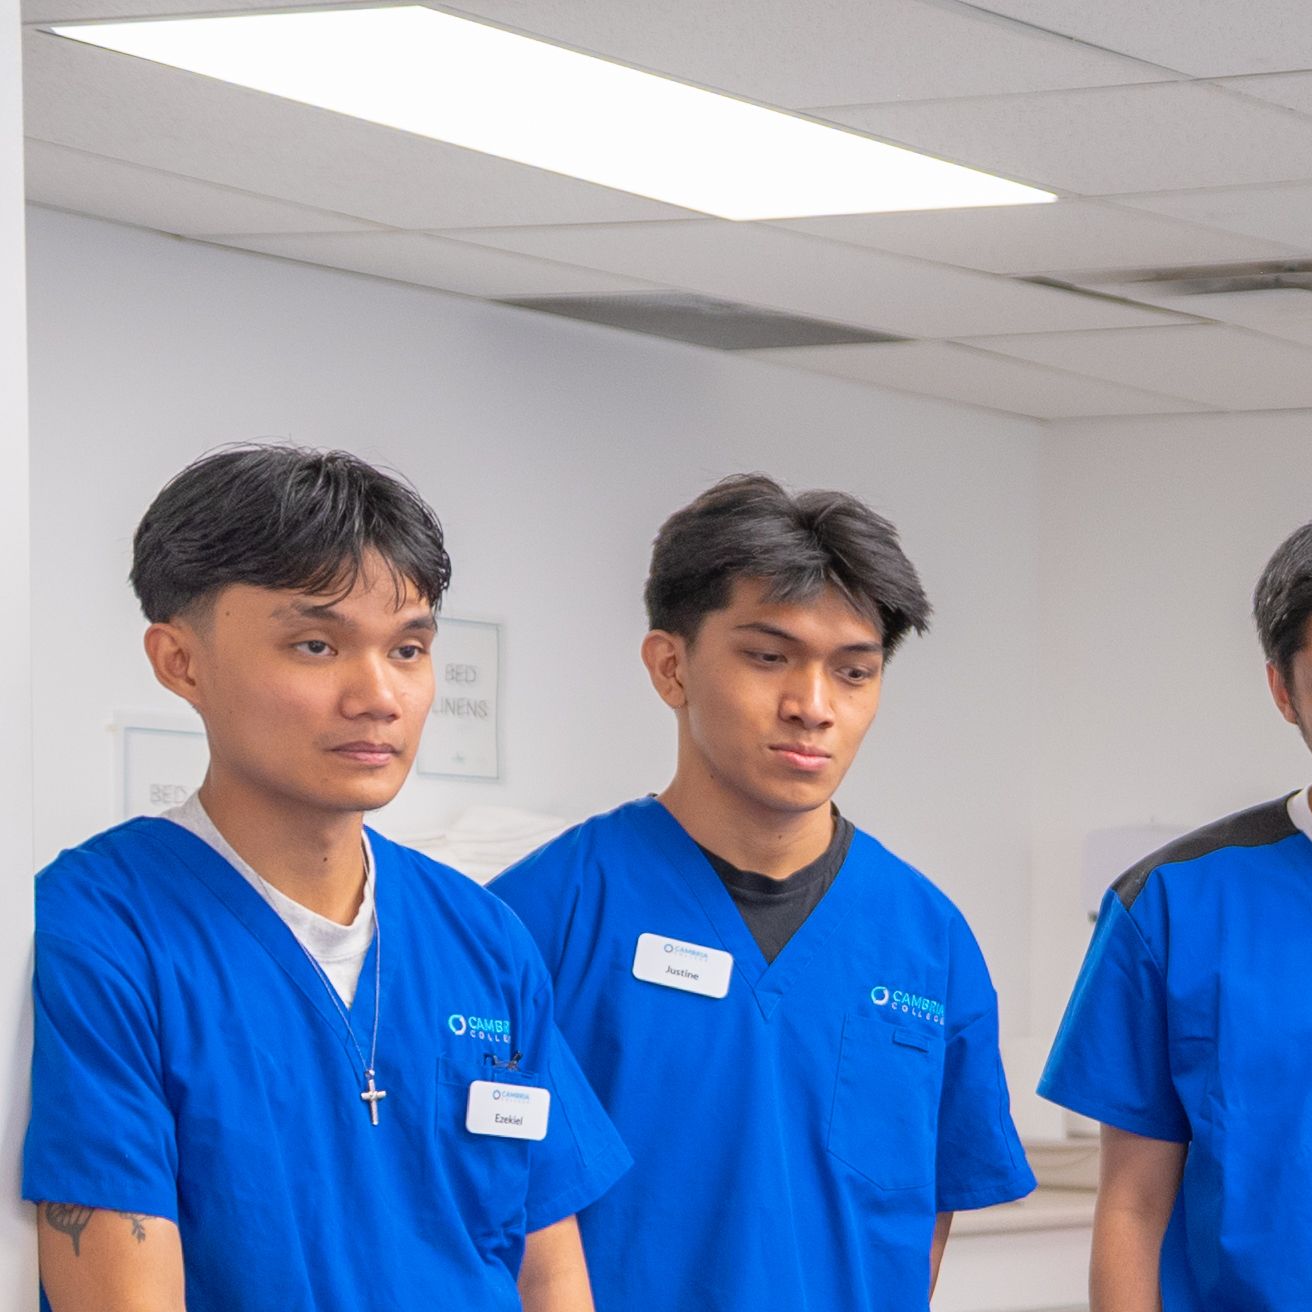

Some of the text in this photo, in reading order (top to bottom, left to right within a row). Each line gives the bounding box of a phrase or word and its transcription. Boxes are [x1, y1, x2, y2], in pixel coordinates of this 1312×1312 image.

[445, 664, 477, 682] BED
[665, 965, 699, 980] Justine
[494, 1113, 523, 1126] Ezekiel
